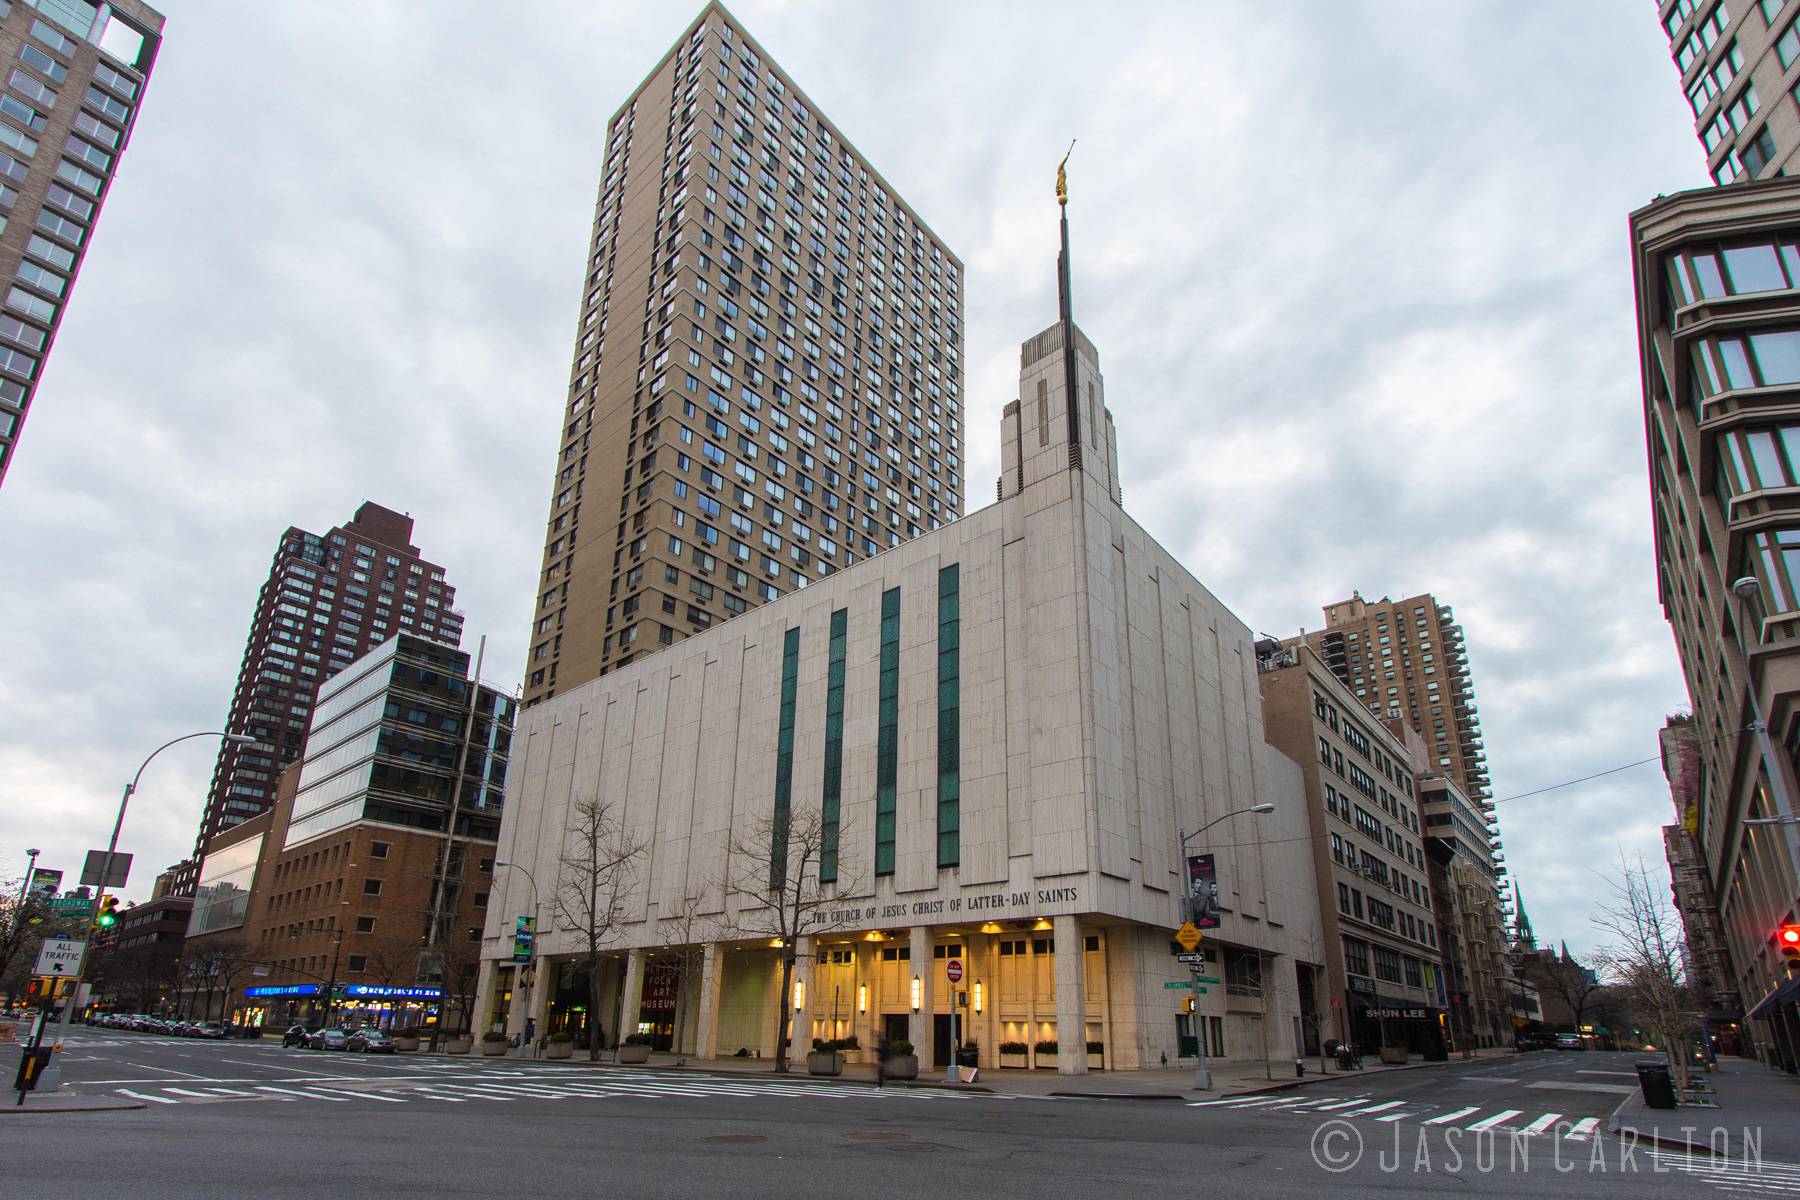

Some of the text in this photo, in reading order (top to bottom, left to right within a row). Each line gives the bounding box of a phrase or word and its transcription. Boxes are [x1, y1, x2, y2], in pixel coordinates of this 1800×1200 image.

[830, 908, 861, 921] CHURCH
[866, 907, 876, 919] OF
[881, 904, 907, 918] JESUS
[912, 900, 944, 915] CHRIST
[950, 898, 961, 911] OF
[968, 891, 1031, 910] LATTER-DAY
[1038, 887, 1077, 904] SAINTS
[517, 933, 532, 941] shop
[56, 943, 72, 951] ALL
[45, 951, 79, 960] TRAFFIC
[649, 976, 671, 985] FOLK
[653, 988, 670, 997] ART
[641, 1000, 676, 1009] MUSEUM
[1366, 1009, 1426, 1018] SHUN LEE
